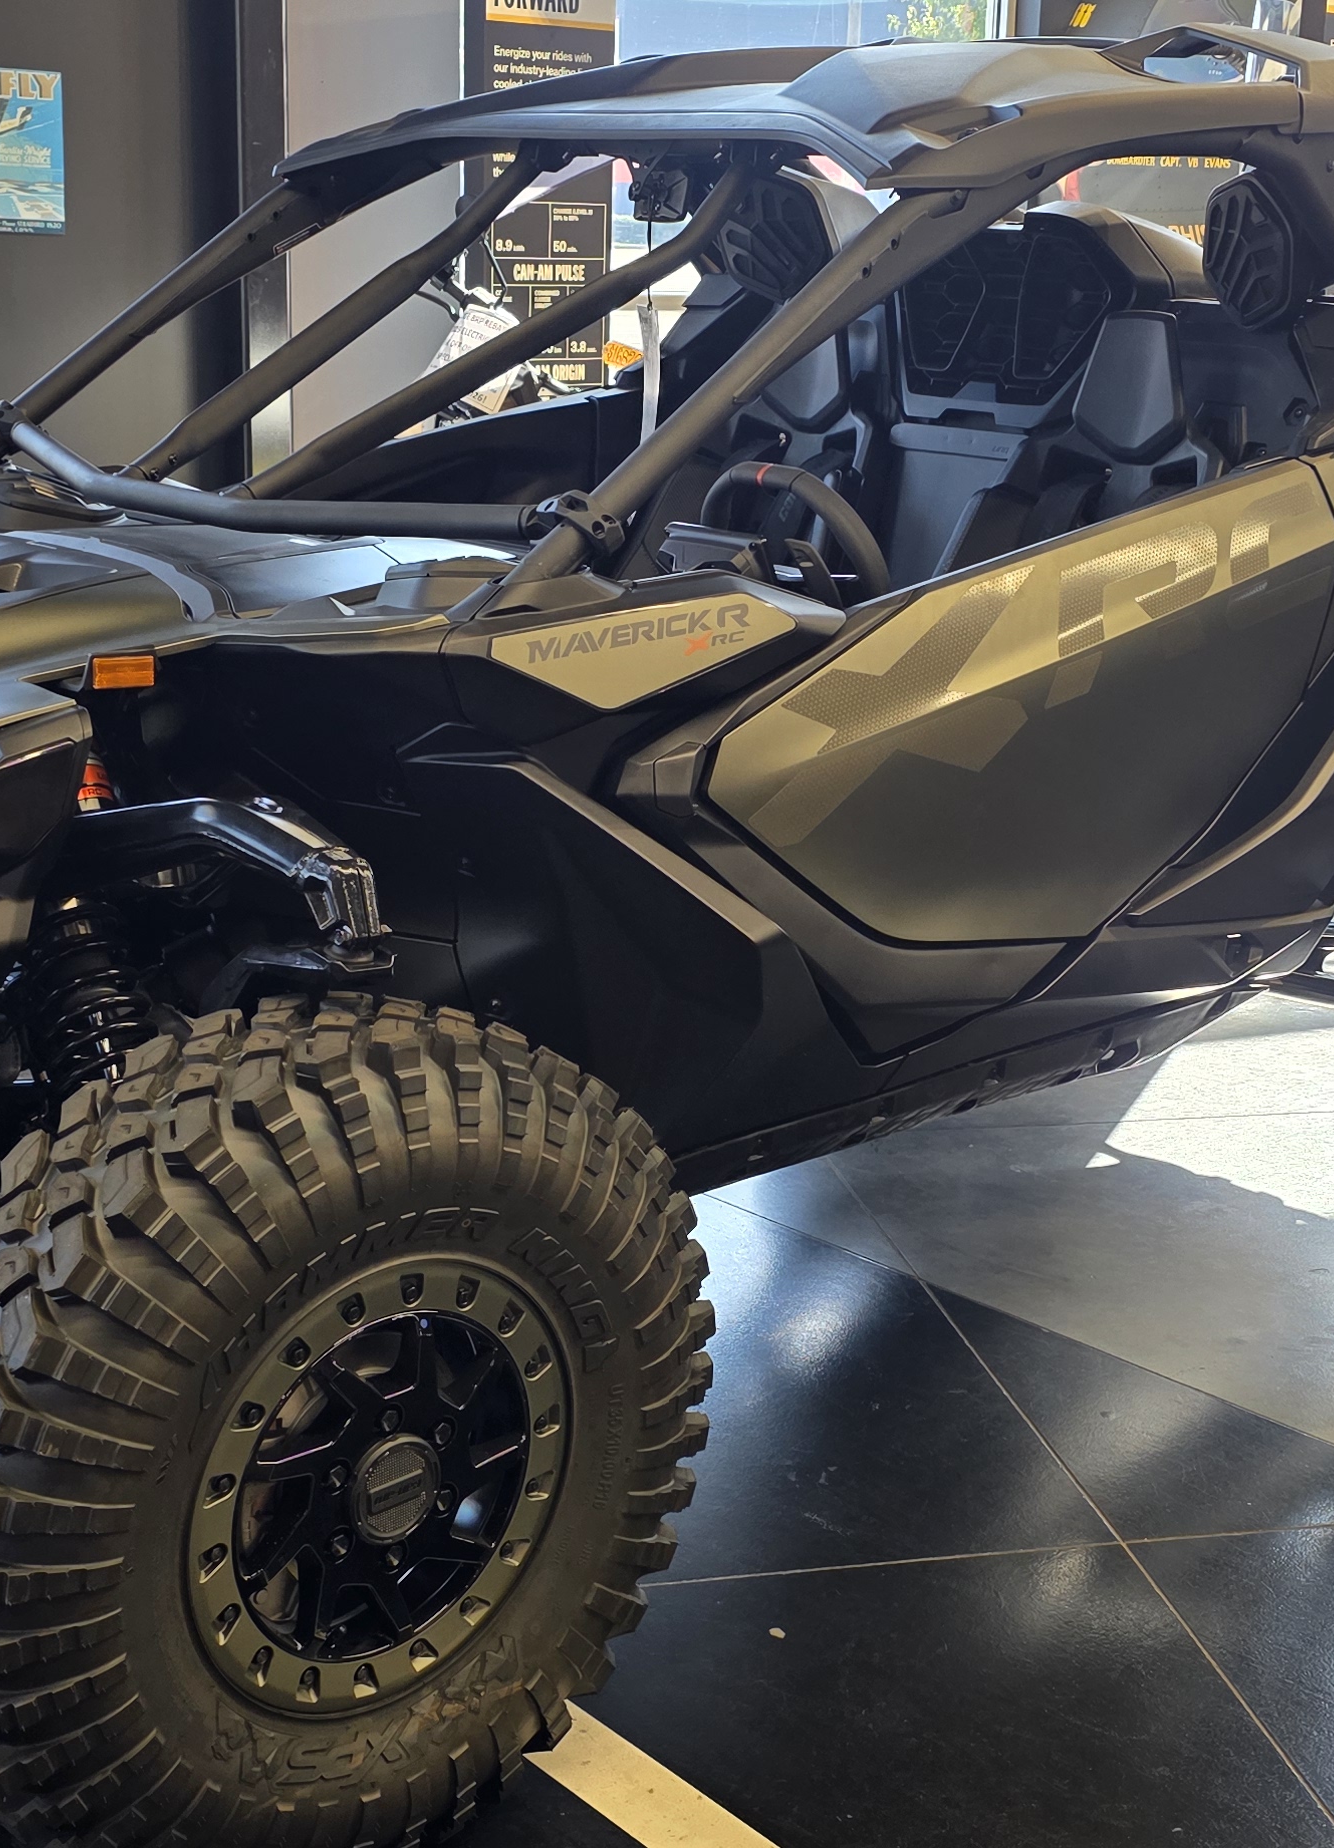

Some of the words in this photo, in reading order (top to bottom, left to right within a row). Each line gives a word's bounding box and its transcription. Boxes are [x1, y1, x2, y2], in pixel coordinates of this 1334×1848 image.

[494, 45, 529, 60] Energize
[532, 51, 550, 61] your
[552, 50, 572, 62] rides
[575, 53, 592, 63] with
[493, 64, 508, 72] our
[1204, 158, 1231, 168] EVANS
[495, 239, 513, 251] 8.9
[553, 241, 567, 252] 50
[513, 264, 553, 281] CAN-AM
[555, 265, 585, 281] PULSE
[571, 341, 586, 353] 3.8
[553, 364, 585, 380] ORIGIN
[527, 609, 713, 663] MAVERICK
[717, 603, 750, 628] R
[507, 1228, 607, 1339] KING
